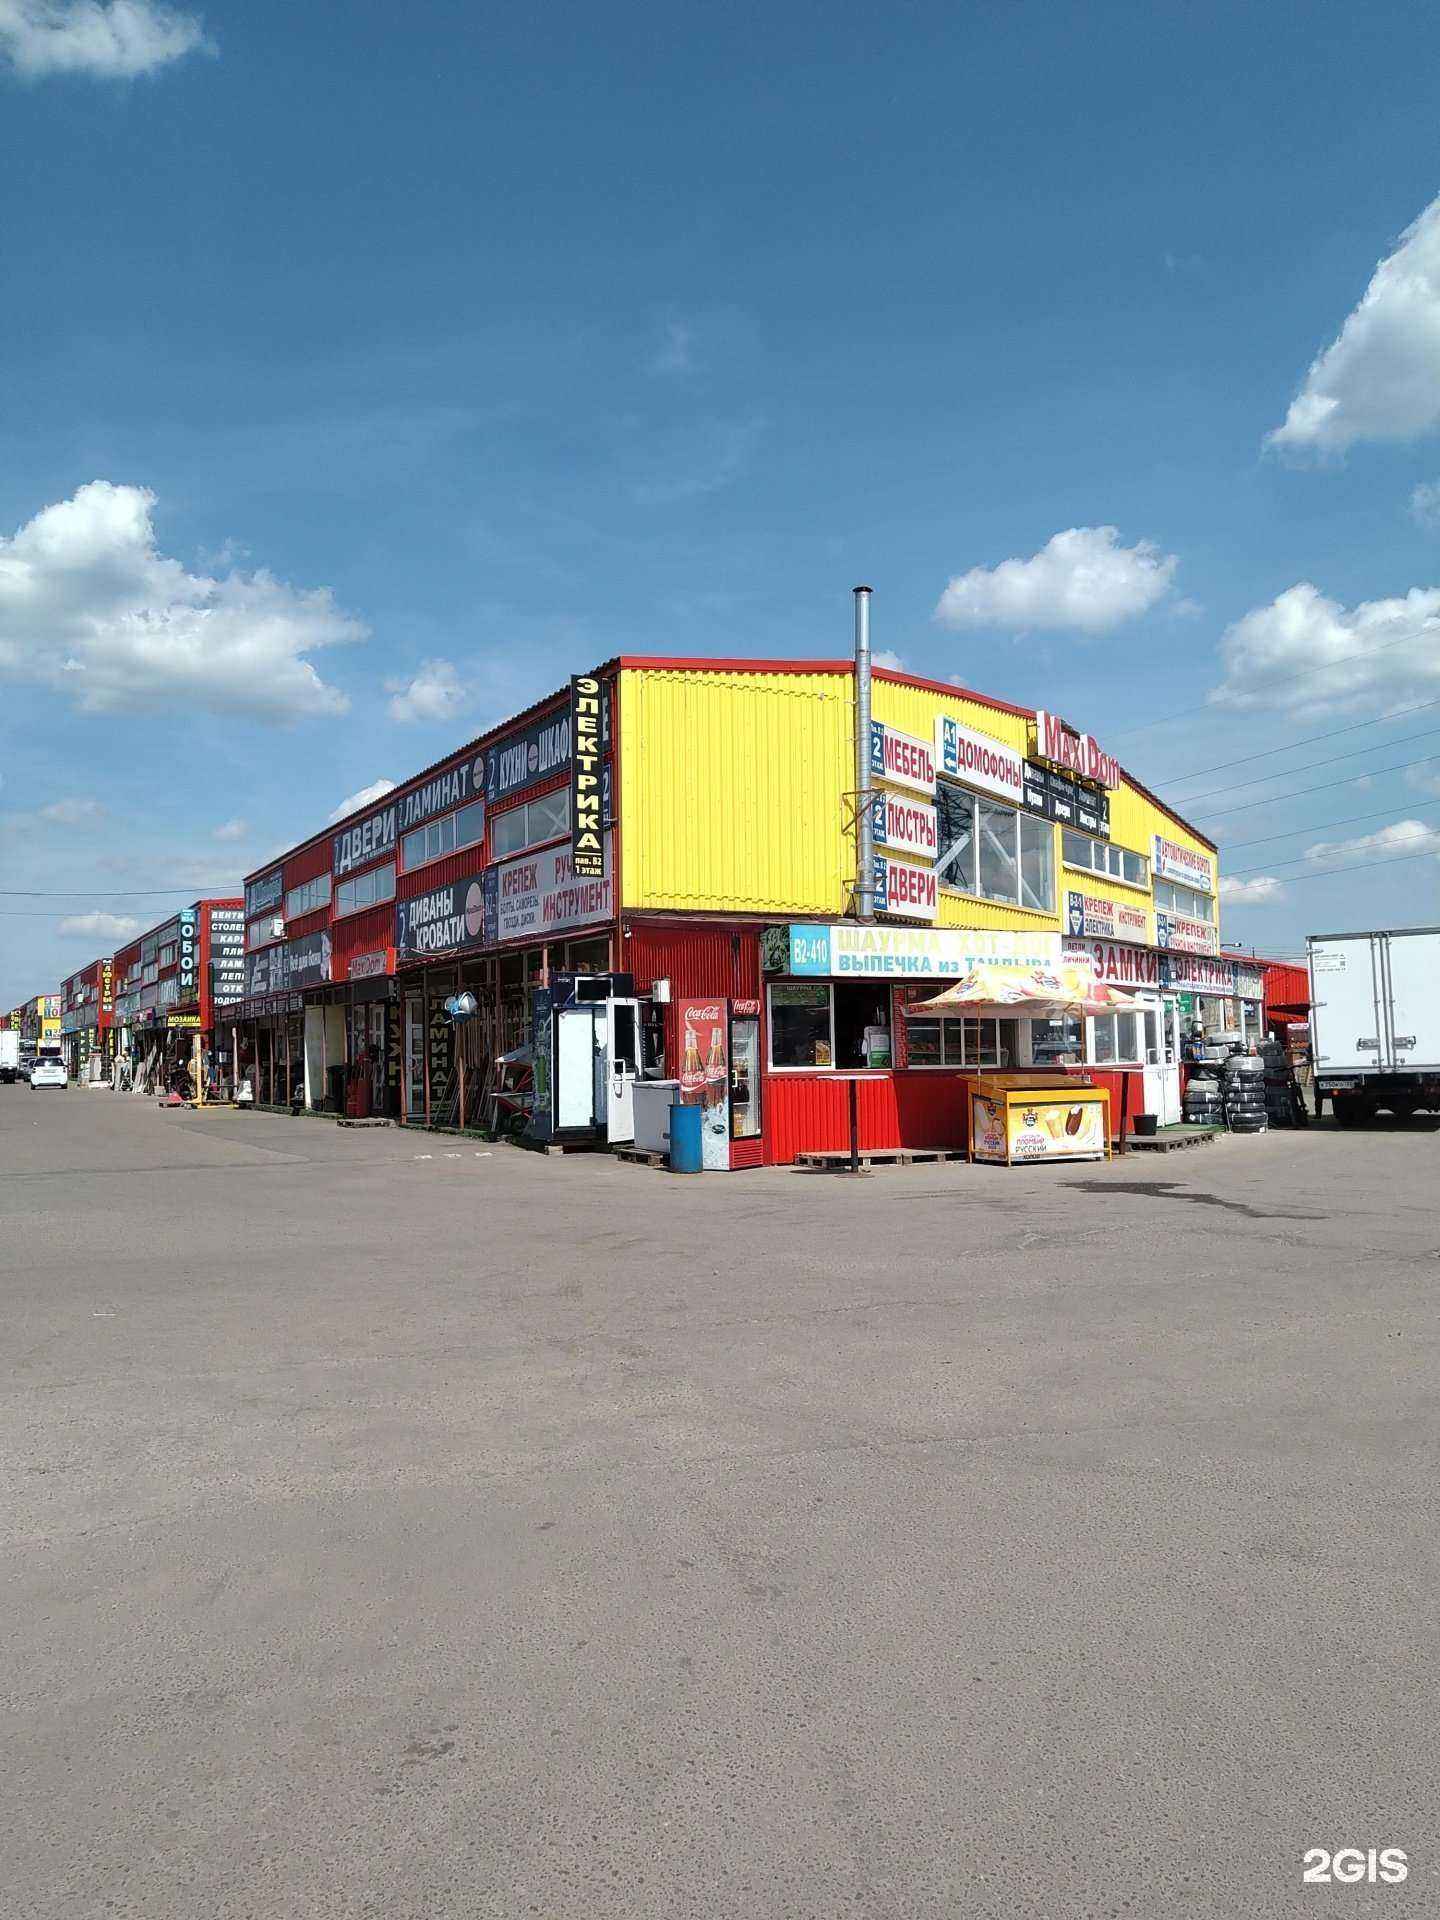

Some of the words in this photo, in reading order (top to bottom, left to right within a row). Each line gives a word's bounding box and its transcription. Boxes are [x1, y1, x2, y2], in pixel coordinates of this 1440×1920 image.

[500, 741, 528, 790] КУХНИ
[575, 678, 601, 849] ЭЛЕКТРИКА
[884, 735, 934, 783] МЕБЕЛЬ
[958, 737, 1022, 789] ДОМОФОНЫ
[404, 764, 469, 826] ЛАМИНАТ
[340, 806, 395, 875] ДВЕРИ
[887, 801, 936, 848] ЛЮСТРЫ
[502, 863, 538, 898] КРЕПЕЖ
[542, 879, 610, 922] ИНСТРУМЕНТ
[888, 865, 936, 908] ДВЕРИ
[409, 887, 453, 932] ДИВАНЫ
[1084, 897, 1114, 916] КРЕПЕЖ
[416, 914, 465, 950] КРОВАТИ
[182, 924, 194, 986] ОБОИ
[839, 954, 932, 973] ВЫПЕЧКА
[939, 961, 960, 973] из
[1093, 943, 1158, 983] ЗАМКИ
[1176, 957, 1234, 986] ЭЛЕКТРИКА
